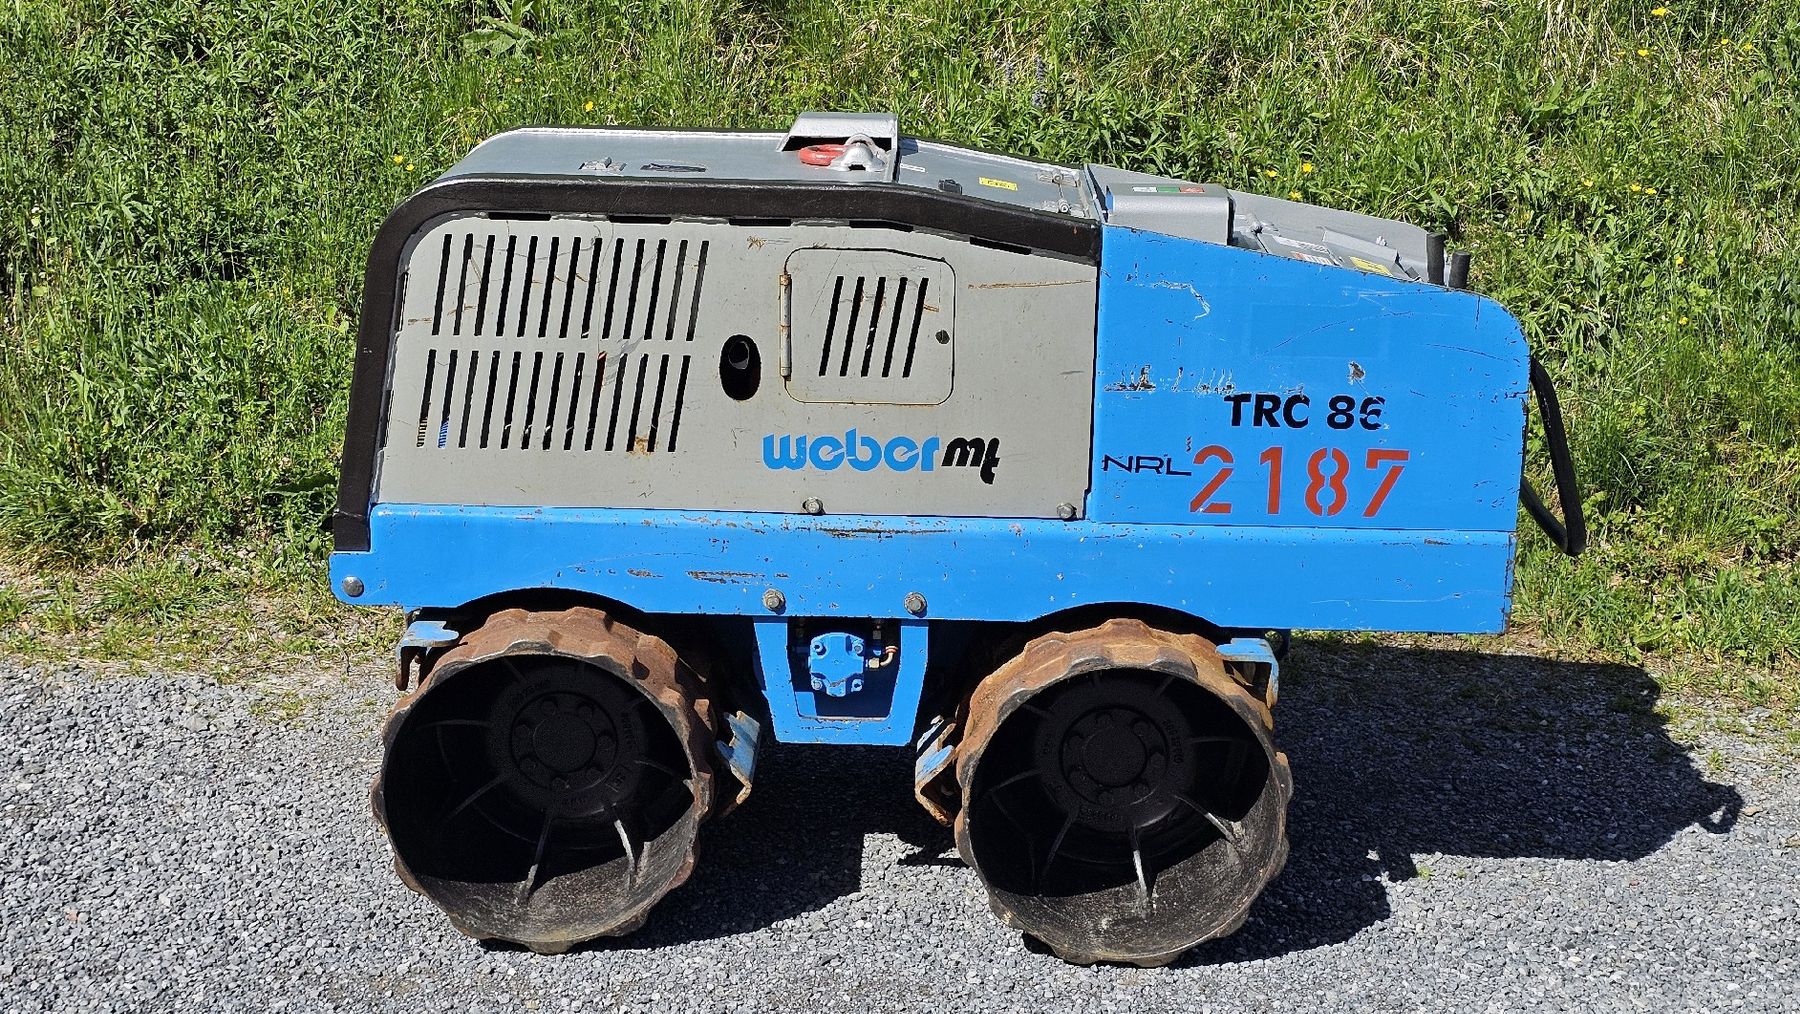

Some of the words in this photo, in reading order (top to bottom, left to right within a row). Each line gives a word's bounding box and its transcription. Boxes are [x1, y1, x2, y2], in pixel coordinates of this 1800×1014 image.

[1224, 393, 1310, 428] TRC
[1102, 455, 1192, 476] NRL
[1191, 445, 1410, 517] 2187
